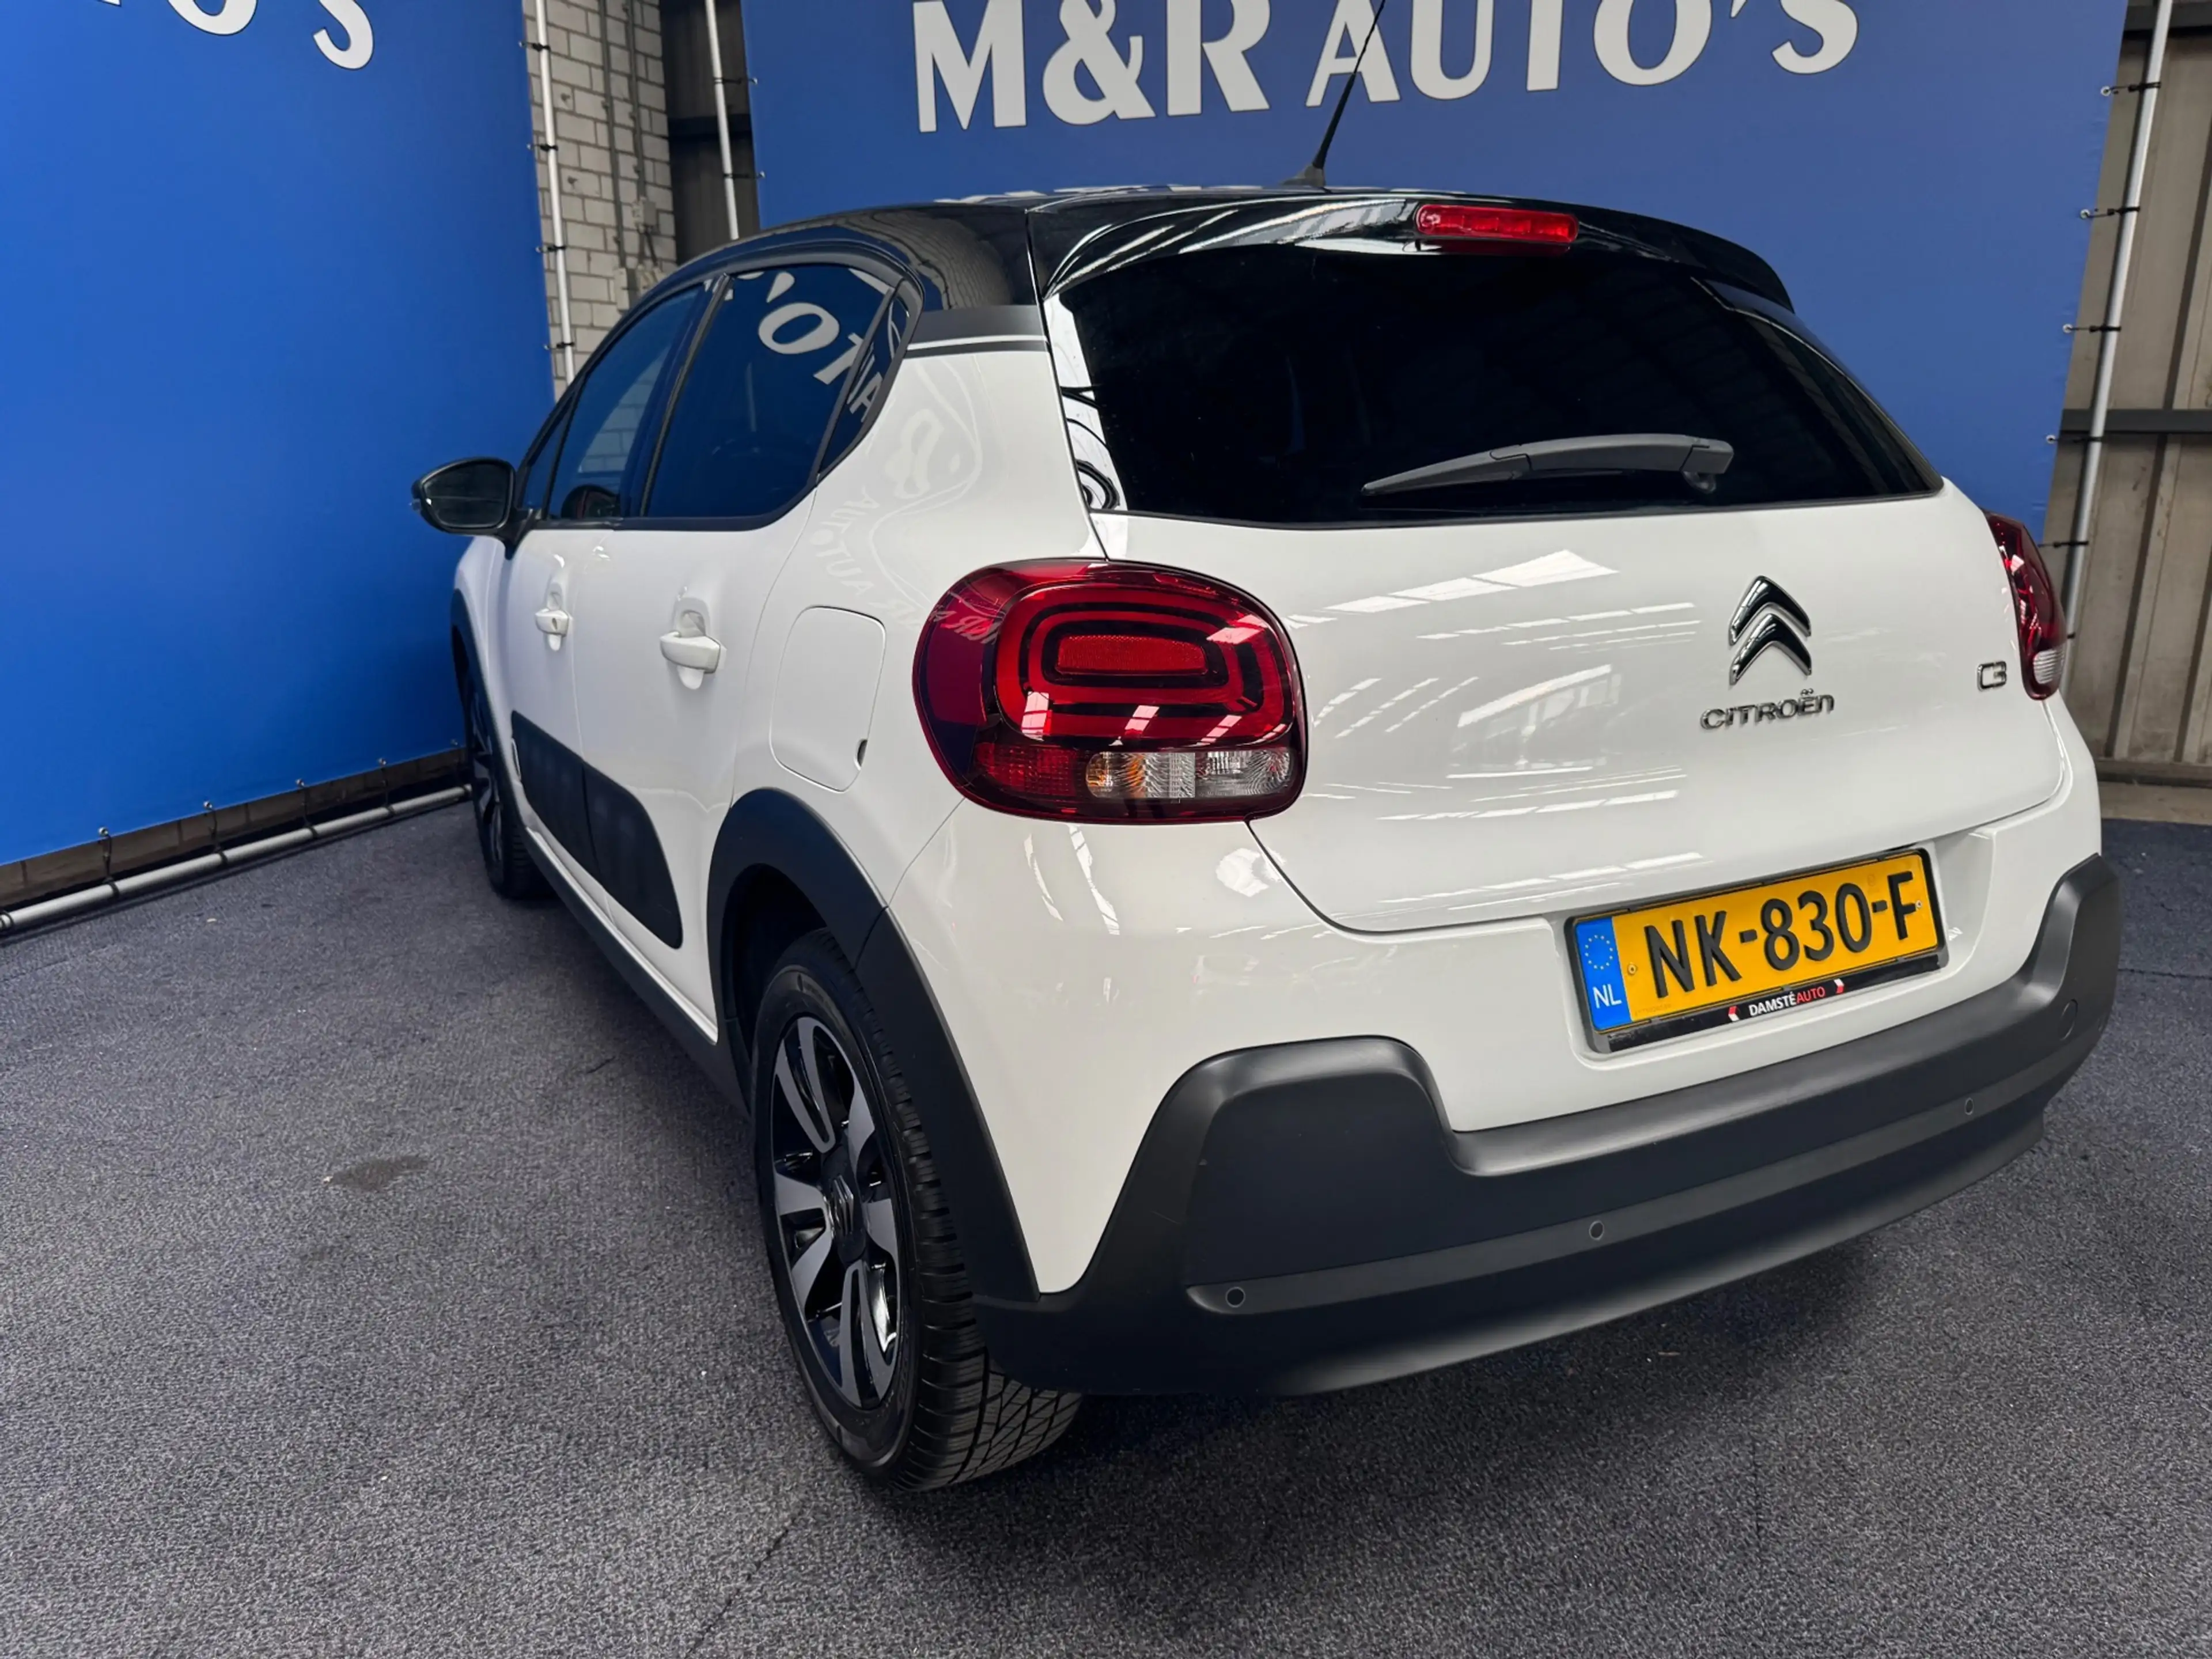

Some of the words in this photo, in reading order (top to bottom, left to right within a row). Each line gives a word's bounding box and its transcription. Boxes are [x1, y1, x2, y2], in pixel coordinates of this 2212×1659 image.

[913, 0, 1270, 132] M&R
[1977, 660, 2007, 692] C3
[1644, 870, 1916, 998] NK-830-F
[1593, 984, 1622, 1009] NL
